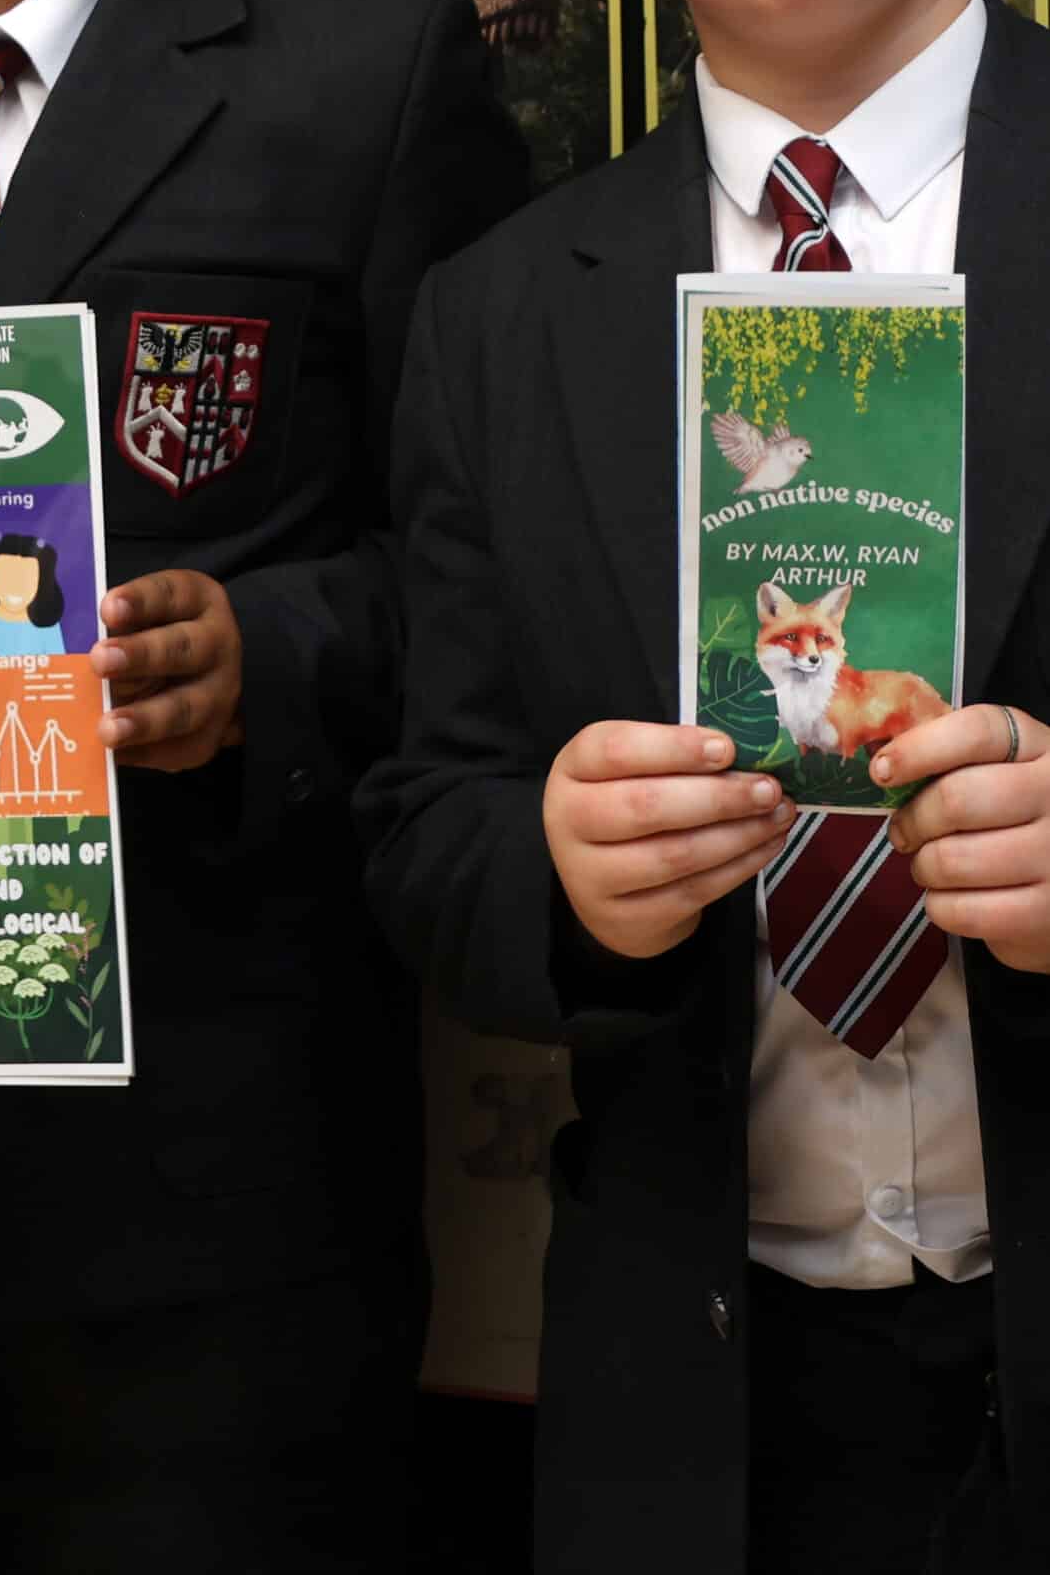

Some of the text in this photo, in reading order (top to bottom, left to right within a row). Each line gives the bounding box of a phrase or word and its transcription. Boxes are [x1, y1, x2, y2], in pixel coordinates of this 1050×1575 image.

[701, 480, 955, 534] non native species
[725, 543, 920, 565] BY MAX.W, RYAN
[771, 567, 867, 587] ARTHUR
[78, 841, 108, 866] OF
